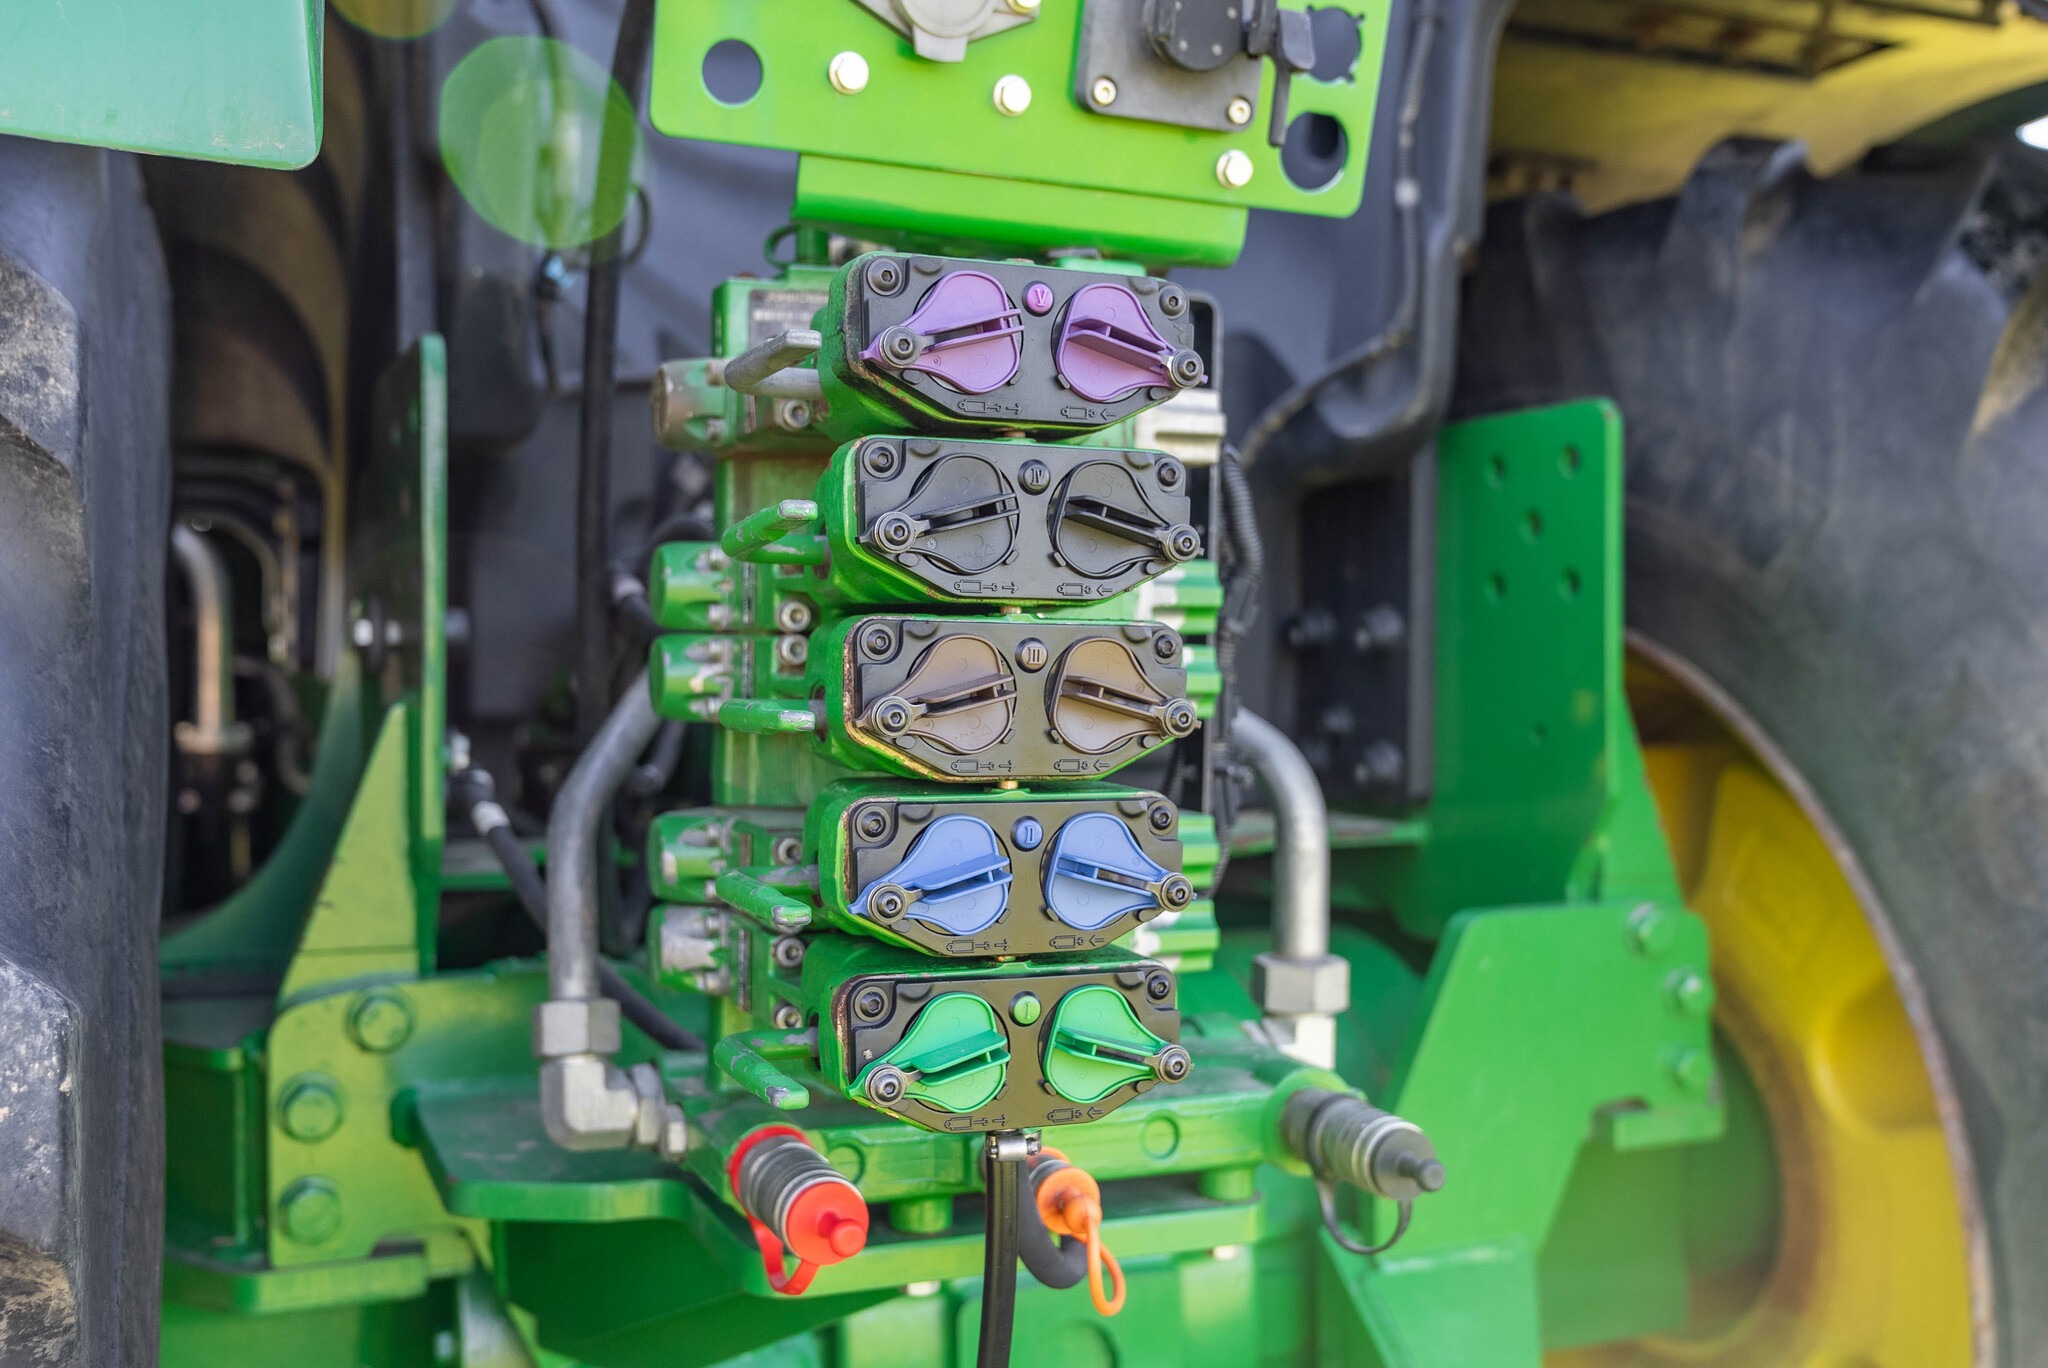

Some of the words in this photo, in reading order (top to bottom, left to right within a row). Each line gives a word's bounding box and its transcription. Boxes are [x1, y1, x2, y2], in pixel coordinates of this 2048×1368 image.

[1034, 288, 1049, 307] V
[1031, 468, 1046, 486] IV
[1027, 647, 1043, 665] III
[1024, 825, 1037, 844] II
[1024, 1001, 1032, 1020] I
